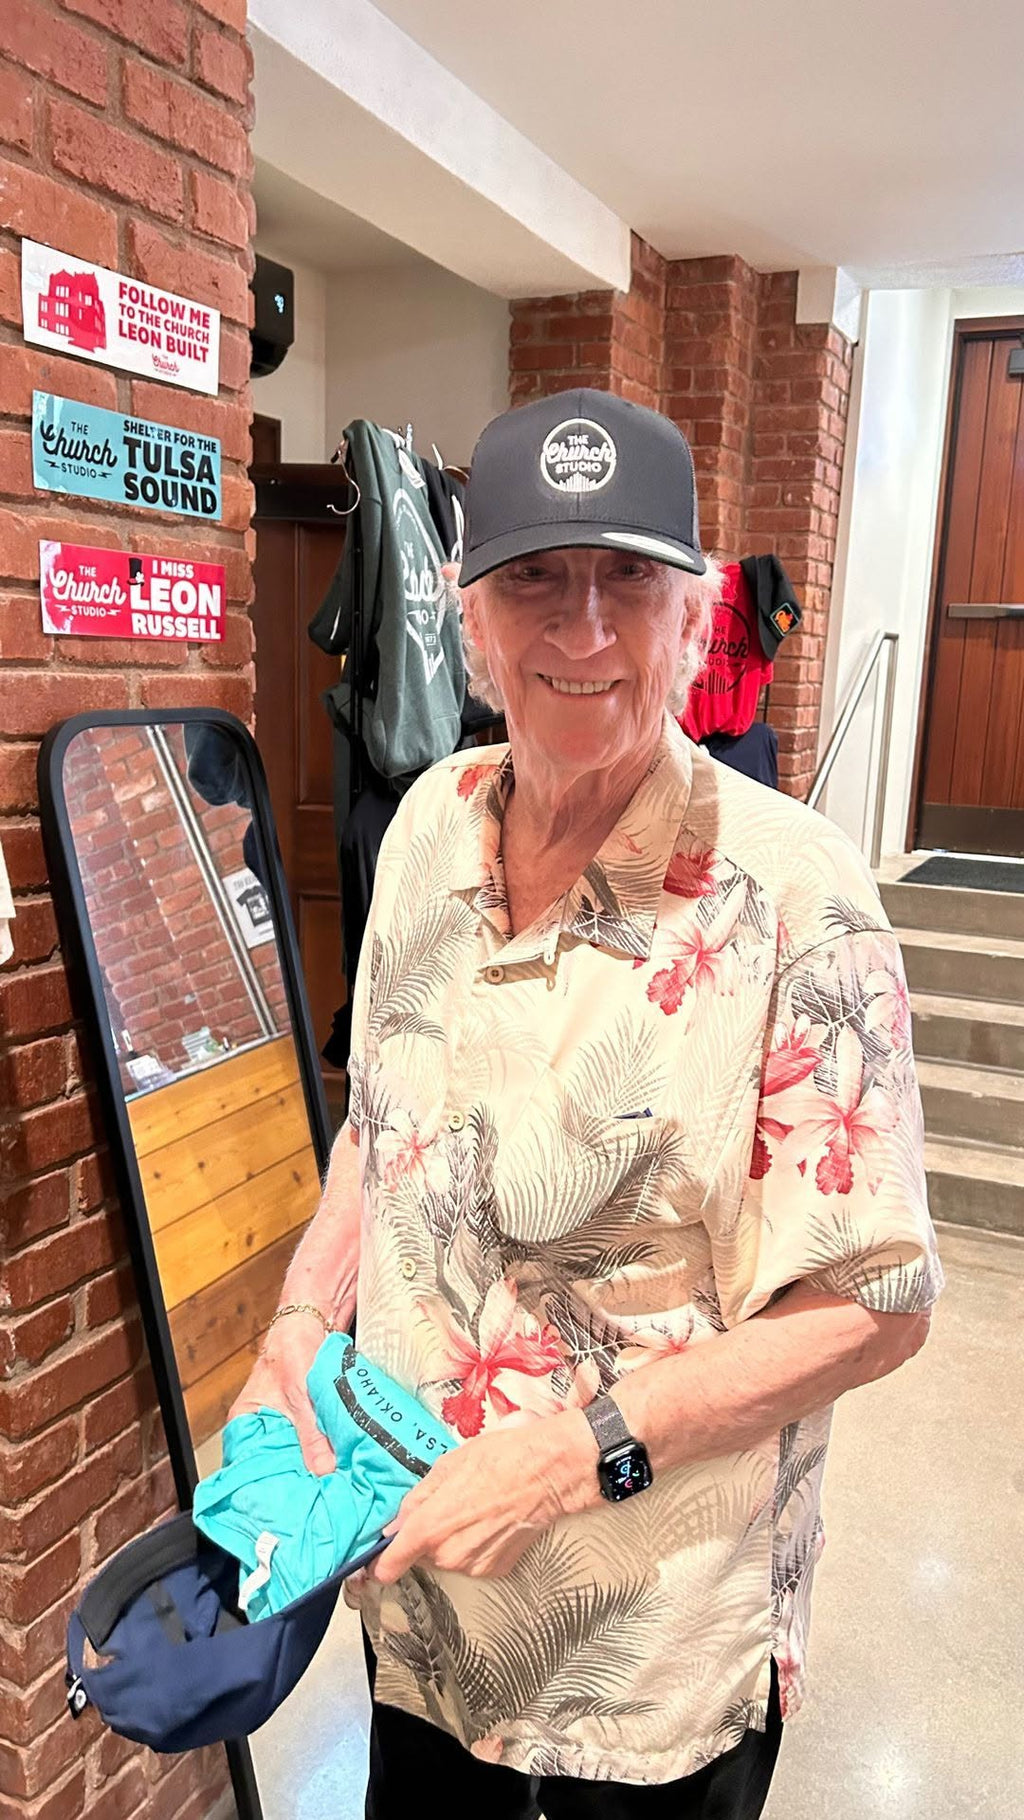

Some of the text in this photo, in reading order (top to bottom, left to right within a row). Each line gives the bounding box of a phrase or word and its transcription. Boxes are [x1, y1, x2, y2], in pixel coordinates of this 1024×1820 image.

[119, 282, 210, 329] FOLLOW ME
[119, 303, 209, 344] TO THE CHURCH
[119, 319, 208, 363] LEON BUILT
[71, 421, 89, 435] THE
[123, 420, 217, 453] SHELTER FOR THE
[567, 434, 589, 446] THE
[40, 420, 118, 468] Church
[544, 441, 613, 464] Church
[61, 462, 97, 478] STUDIO
[123, 436, 216, 485] TULSA
[555, 461, 602, 474] STUDIO
[123, 472, 217, 514] SOUND
[79, 565, 97, 577] THE
[152, 560, 194, 579] I MISS
[50, 570, 127, 606] Church
[130, 577, 221, 617] LEON
[71, 605, 107, 618] STUDIO
[131, 613, 221, 640] RUSSELL
[714, 626, 727, 635] HE
[413, 1422, 448, 1455] LSA,
